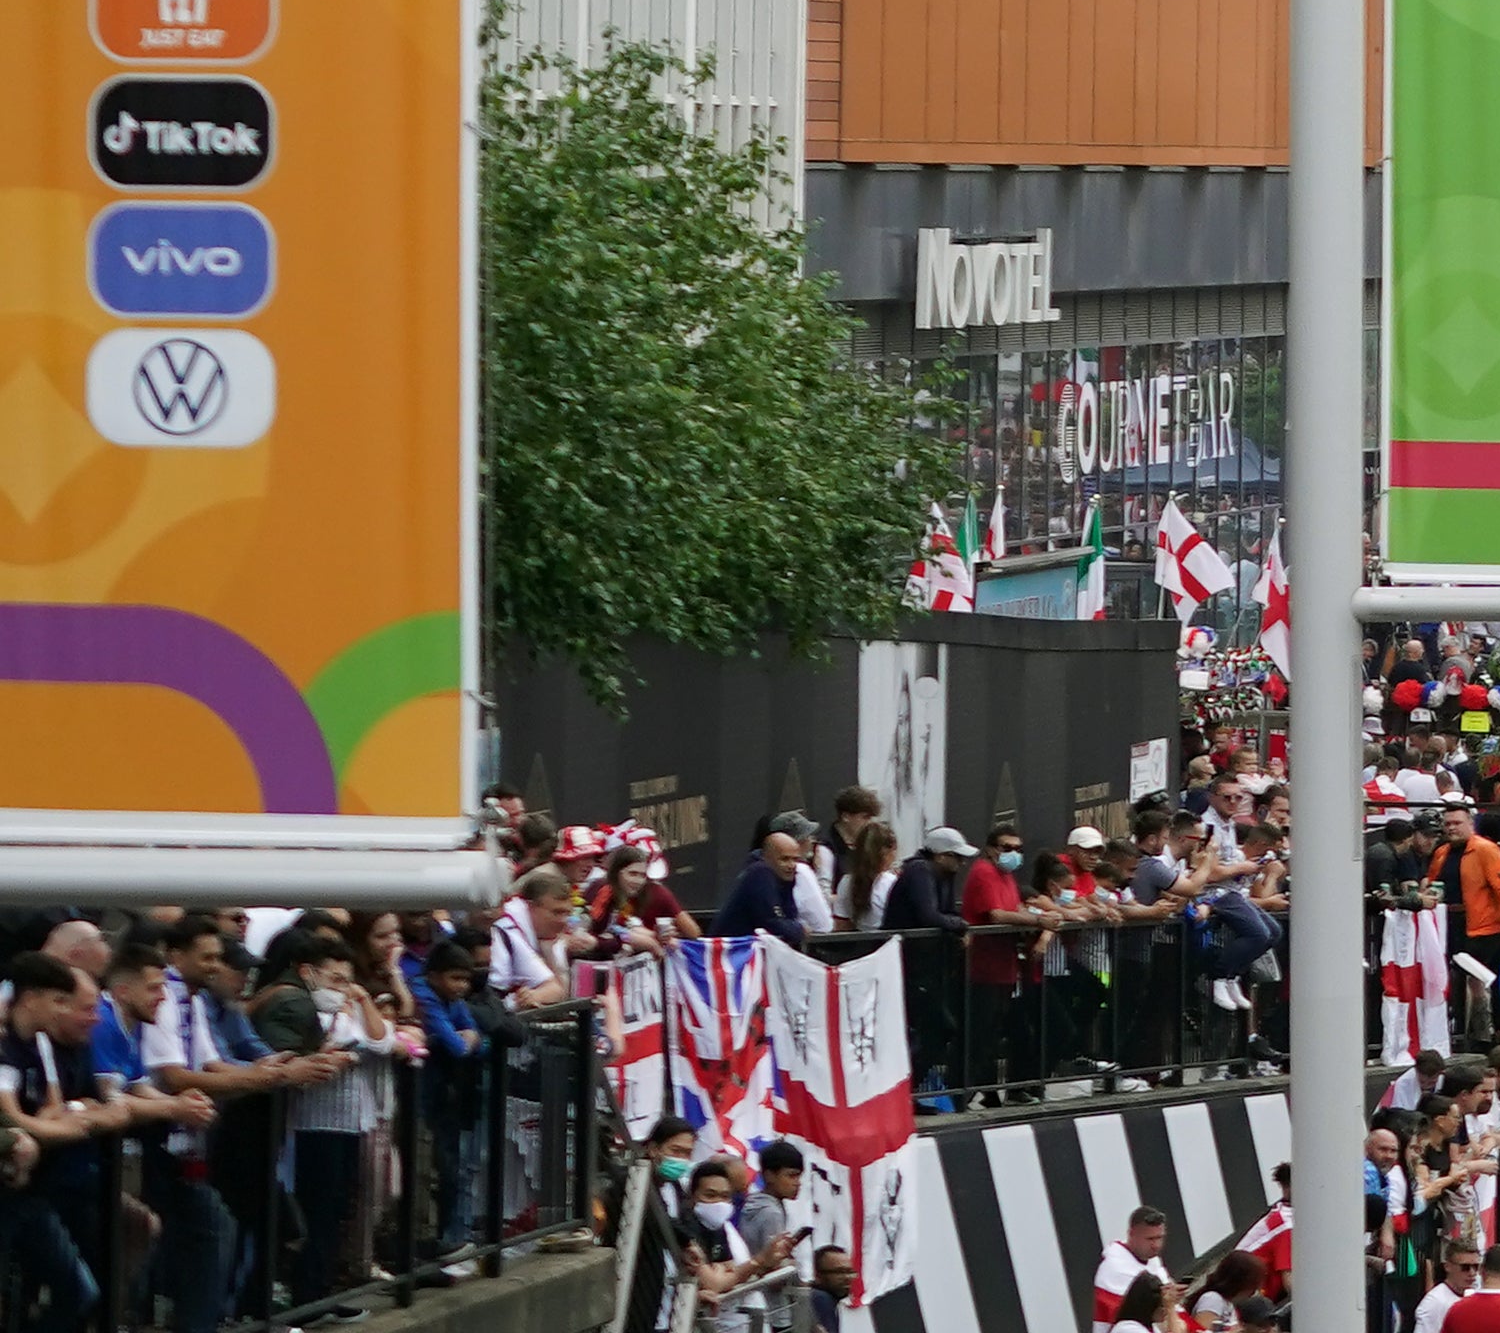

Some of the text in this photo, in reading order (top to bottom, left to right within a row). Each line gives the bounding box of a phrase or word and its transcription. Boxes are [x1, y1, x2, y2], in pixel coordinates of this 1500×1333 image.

[139, 28, 226, 49] JUST EAT
[141, 121, 261, 156] TikTok
[121, 239, 243, 276] vivo
[915, 227, 1061, 330] NOVOTEL
[1057, 375, 1188, 483] GOURMET
